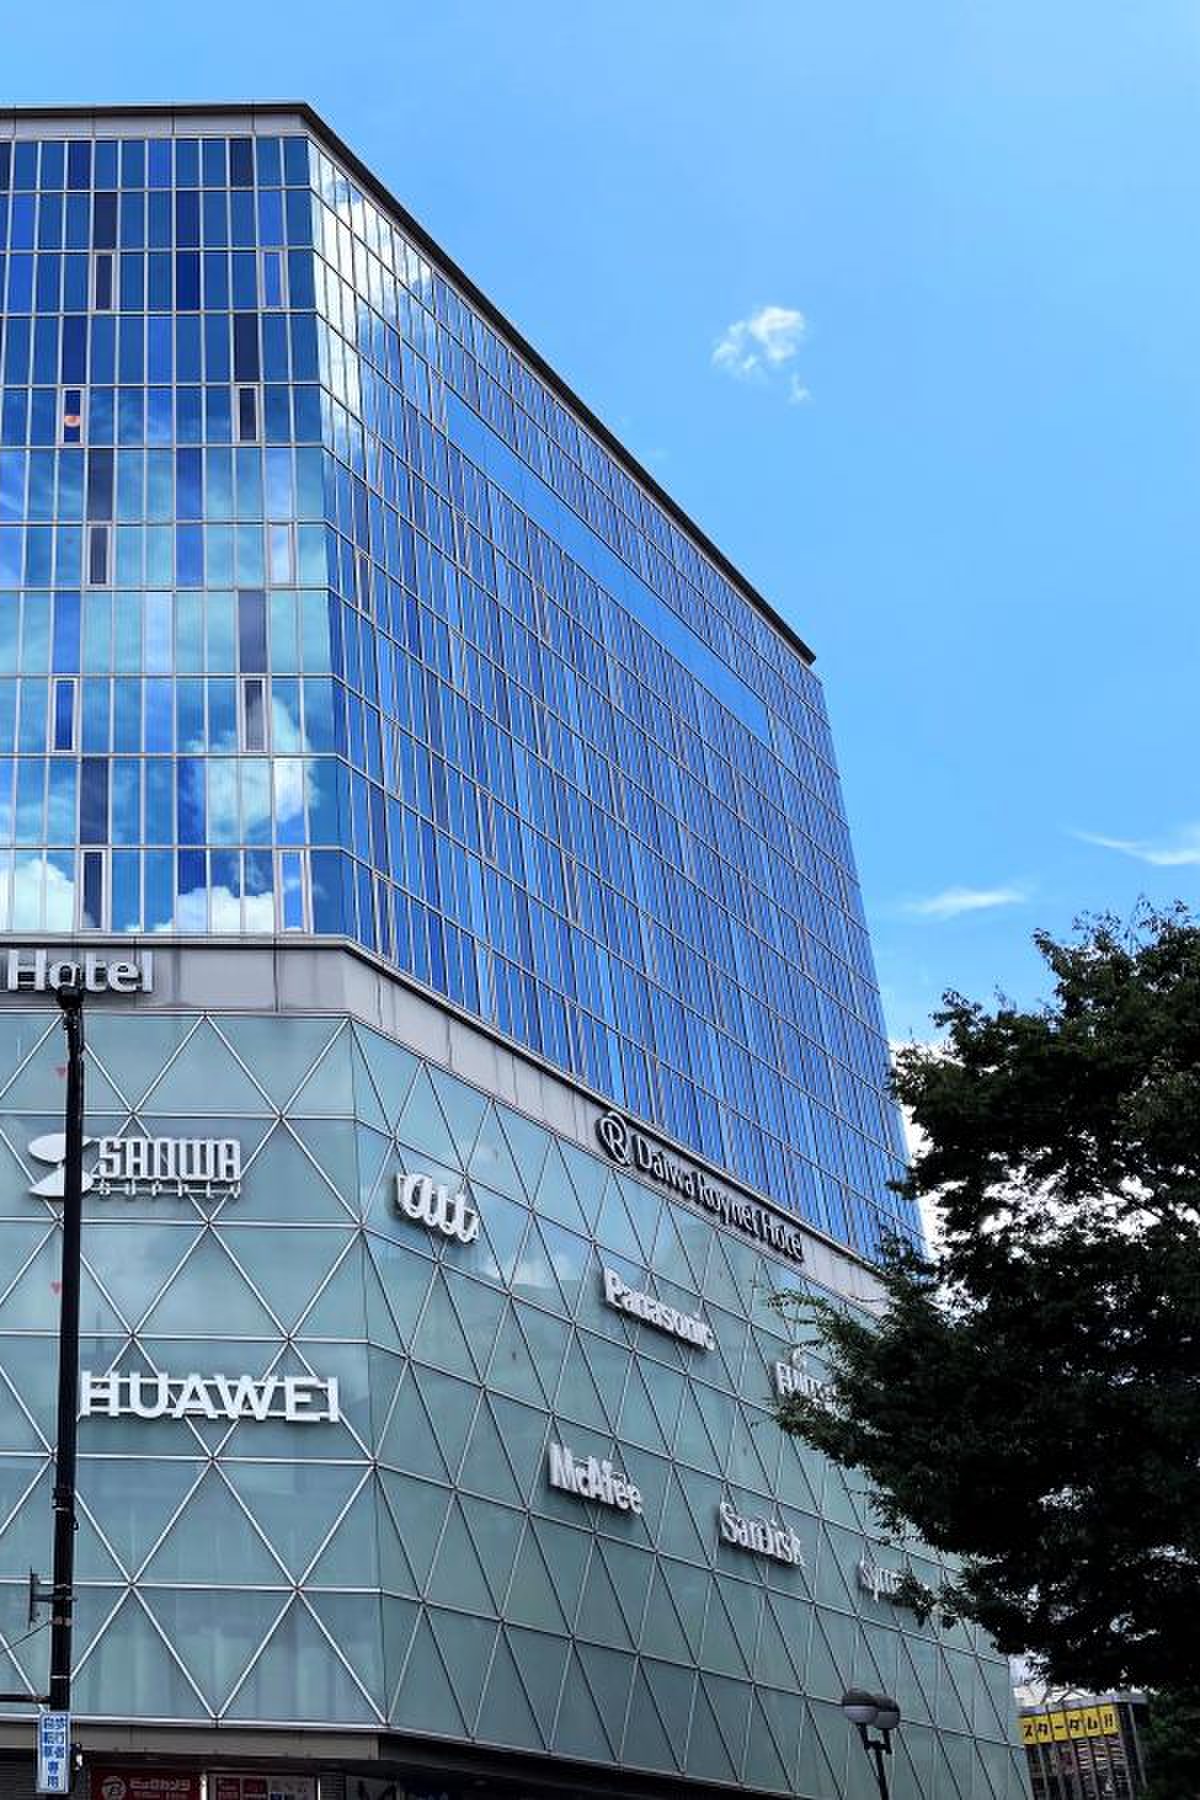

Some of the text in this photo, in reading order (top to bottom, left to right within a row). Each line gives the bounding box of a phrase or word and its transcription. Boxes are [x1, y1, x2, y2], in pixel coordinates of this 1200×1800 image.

[7, 949, 154, 993] Hotel
[99, 1136, 241, 1182] SANWA
[636, 1134, 696, 1197] Daiwa
[604, 1266, 717, 1351] Panasonic
[79, 1370, 340, 1423] HUAWEI
[549, 1442, 642, 1515] McAfee
[720, 1502, 804, 1567] SanDisk
